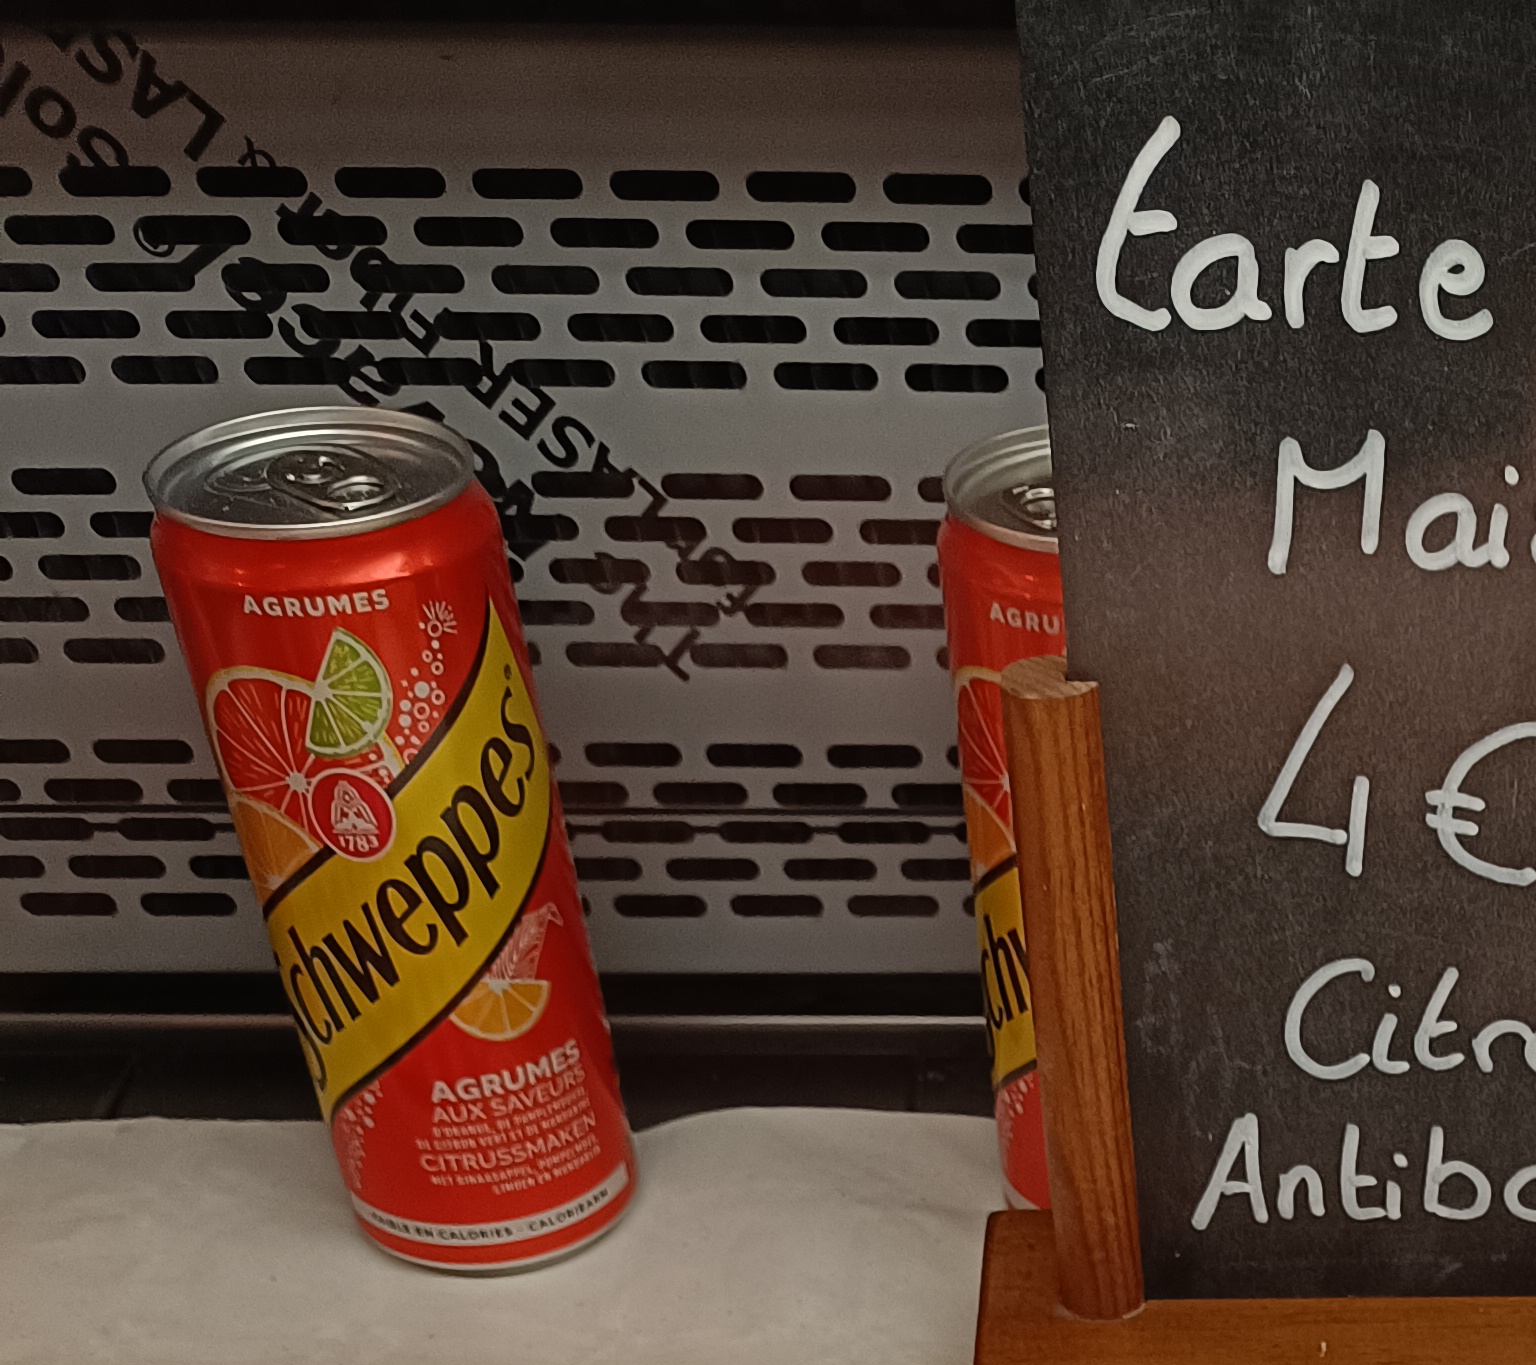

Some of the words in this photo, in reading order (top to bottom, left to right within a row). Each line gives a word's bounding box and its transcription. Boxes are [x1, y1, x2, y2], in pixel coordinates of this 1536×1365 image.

[47, 28, 225, 161] LAS
[1094, 115, 1494, 341] tarte
[462, 338, 668, 519] LASER
[243, 588, 390, 618] AGRUMES
[431, 1038, 581, 1104] AGRUMES
[432, 1102, 488, 1125] AUX
[492, 1063, 587, 1117] SAVEURS
[419, 1110, 598, 1174] CITRUSSMAKEN
